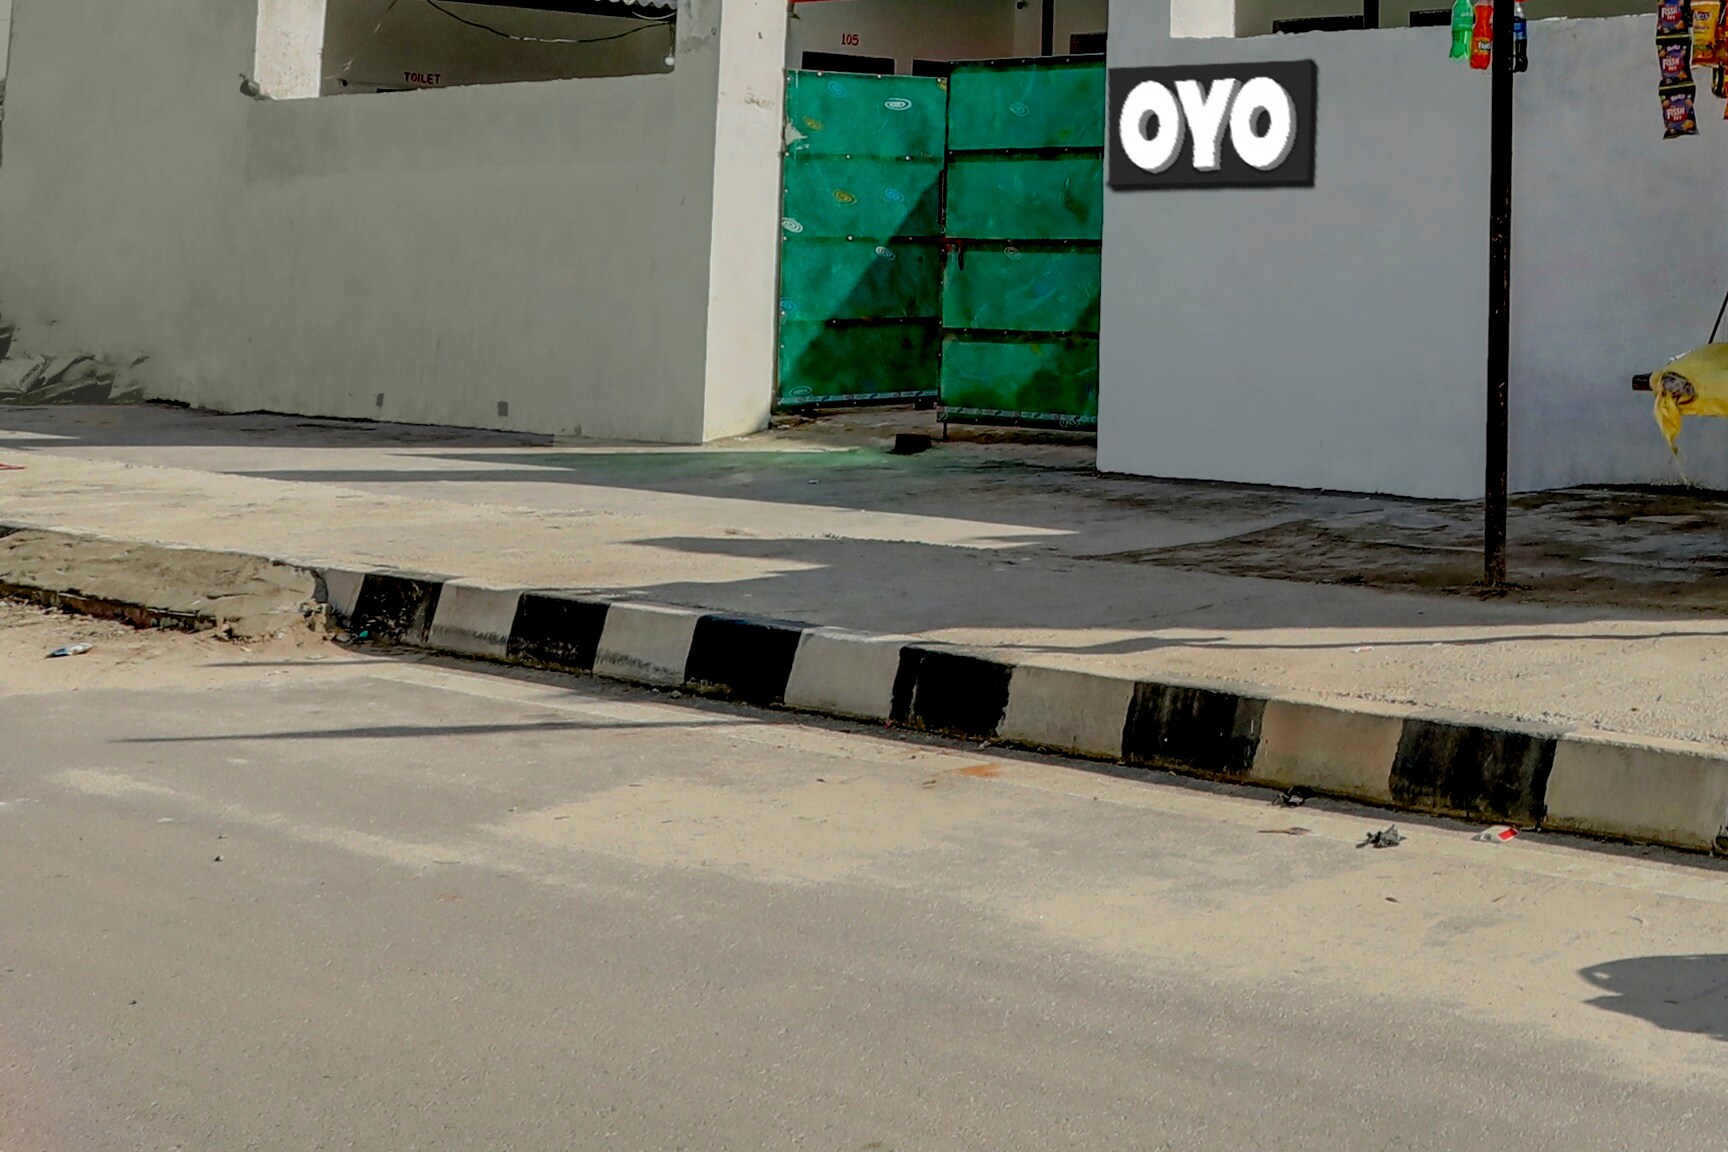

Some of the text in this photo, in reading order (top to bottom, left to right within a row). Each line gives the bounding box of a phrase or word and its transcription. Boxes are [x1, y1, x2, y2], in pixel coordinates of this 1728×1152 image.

[841, 33, 859, 46] 105
[403, 71, 442, 85] TOILET
[1119, 76, 1297, 175] OYO
